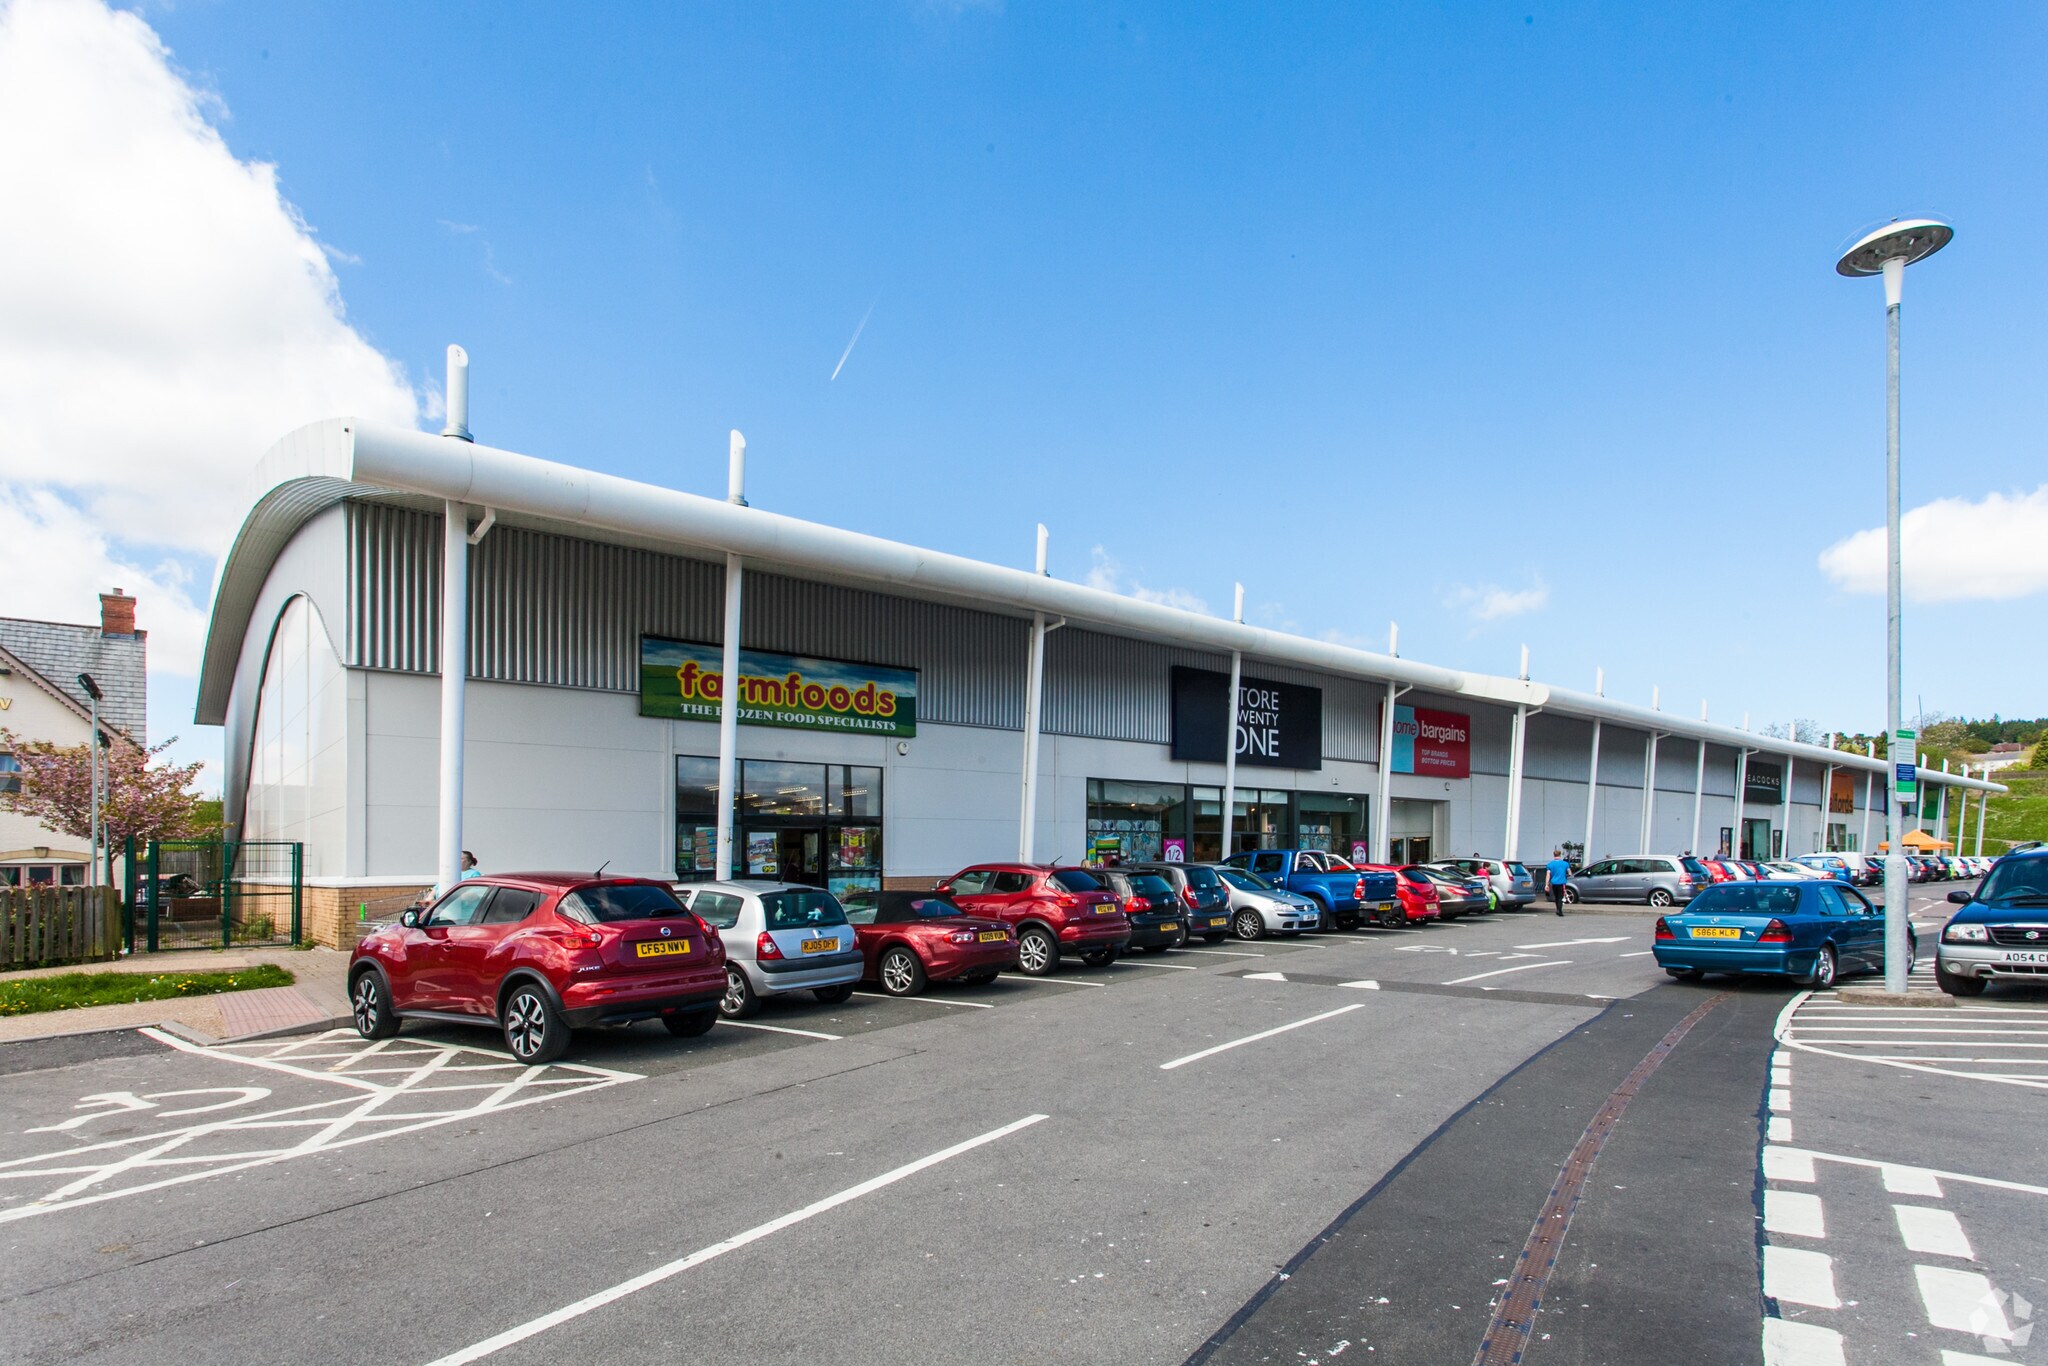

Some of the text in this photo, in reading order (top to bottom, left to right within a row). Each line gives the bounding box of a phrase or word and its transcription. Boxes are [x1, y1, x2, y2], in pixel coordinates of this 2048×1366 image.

[681, 703, 896, 731] THE FOZEN FOOD SPECIALISTS
[1237, 709, 1279, 727] WENTY
[1421, 720, 1466, 744] bargains
[1235, 725, 1280, 757] ONE
[1747, 774, 1780, 786] EACOCKS
[1829, 792, 1854, 814] alfords
[1168, 849, 1181, 861] 1/2
[1696, 928, 1736, 936] S866 MLR
[640, 940, 686, 954] CF63 NWV
[2005, 953, 2048, 962] AO54 C
[577, 965, 600, 973] JUKE
